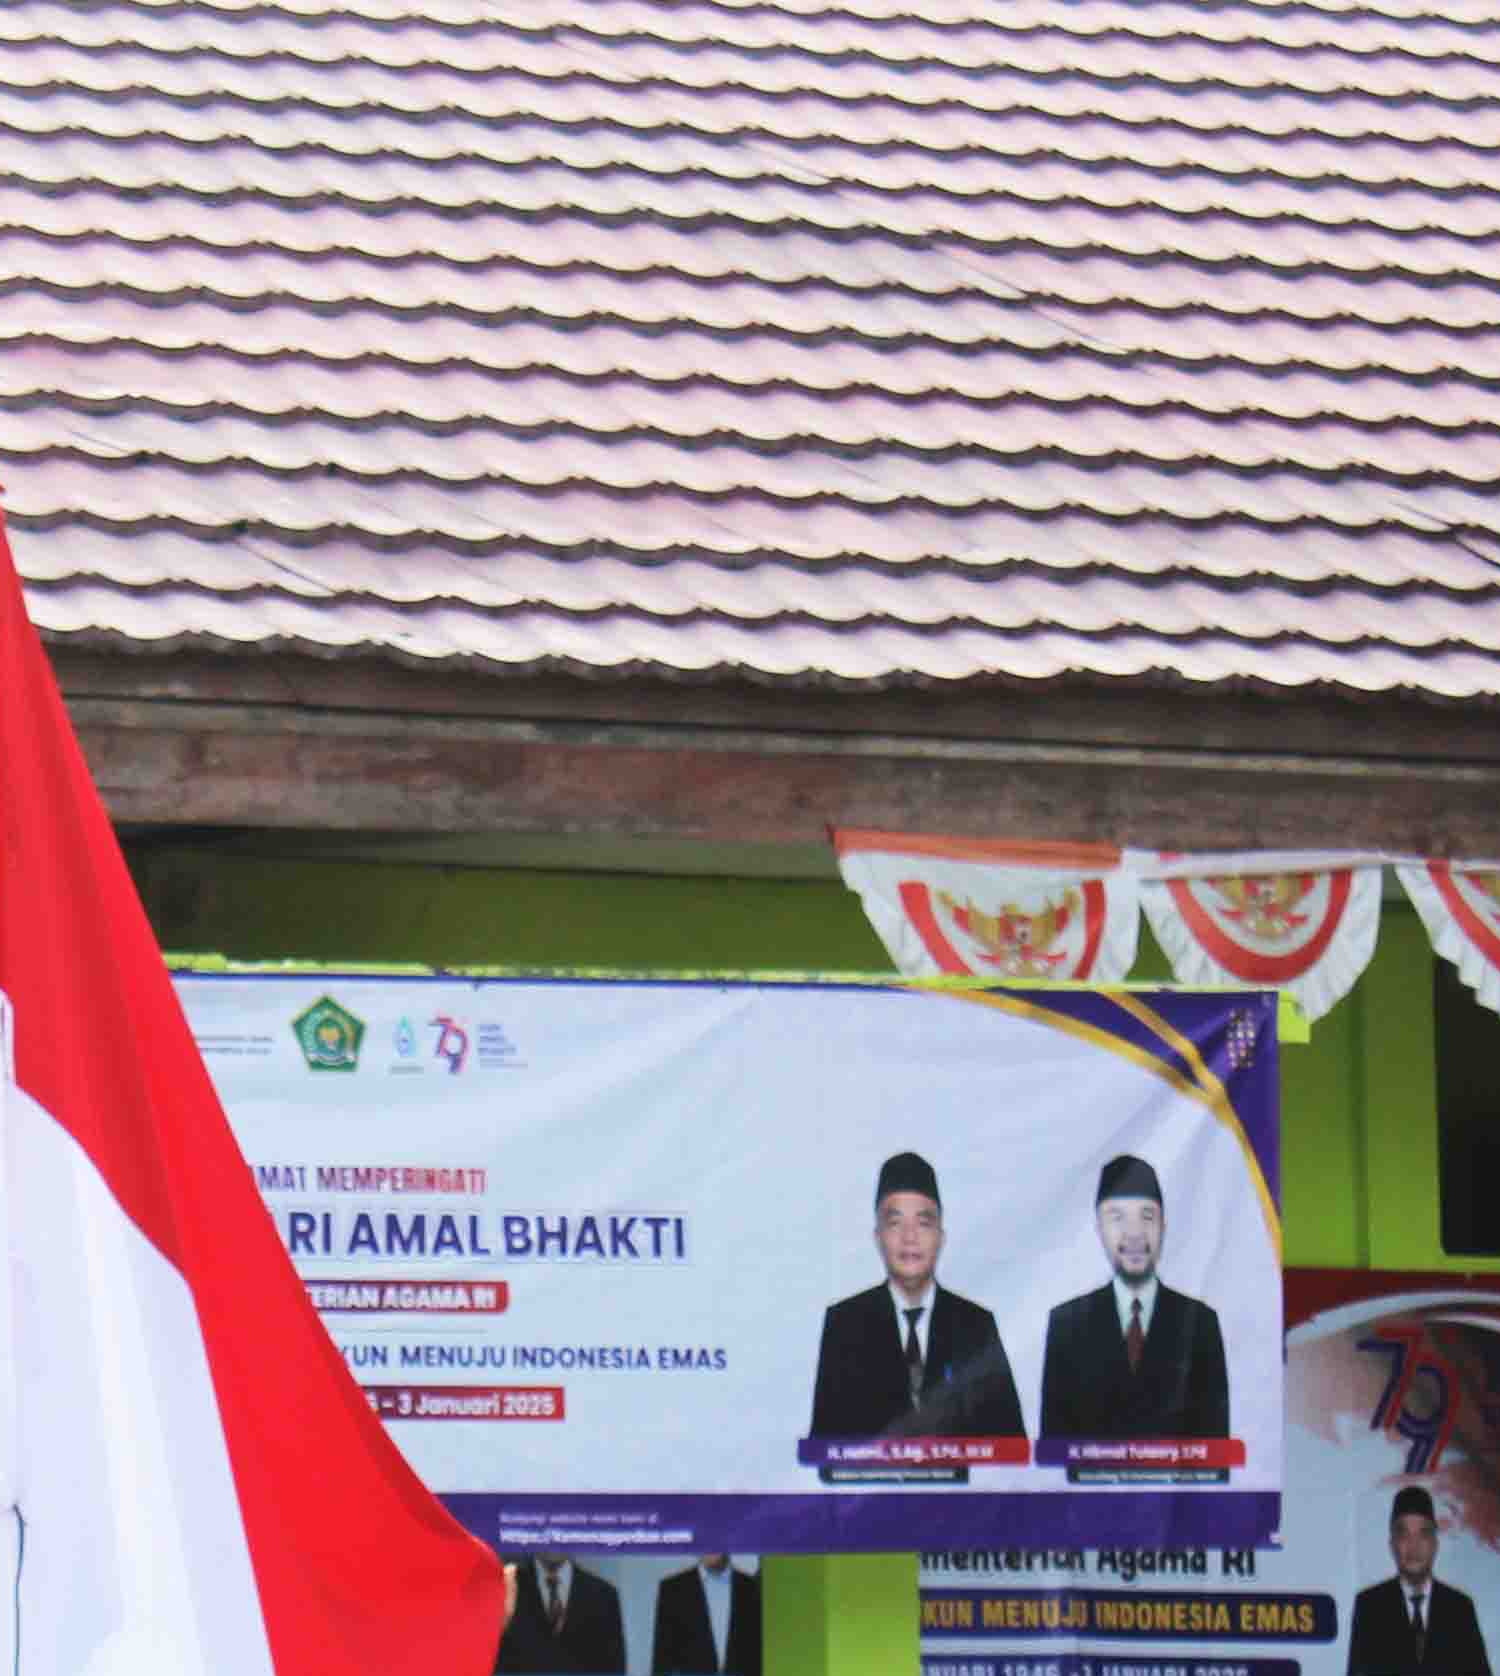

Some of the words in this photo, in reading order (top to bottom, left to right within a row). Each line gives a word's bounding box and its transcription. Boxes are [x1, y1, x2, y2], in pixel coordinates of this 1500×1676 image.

[249, 1165, 306, 1192] MAT
[317, 1166, 487, 1194] MEMPERINGATI
[348, 1212, 491, 1256] AMAL
[502, 1214, 686, 1259] BHAKTI
[383, 1288, 466, 1309] AGAMA
[471, 1289, 498, 1309] RI
[400, 1345, 506, 1368] MENUJU
[512, 1346, 652, 1370] INDONESIA
[658, 1347, 728, 1371] EMAS
[415, 1391, 499, 1417] Januari
[503, 1392, 556, 1416] 2025
[983, 1600, 1089, 1631] MENUJU
[1096, 1602, 1232, 1632] INDONESIA
[1240, 1603, 1315, 1633] EMAS
